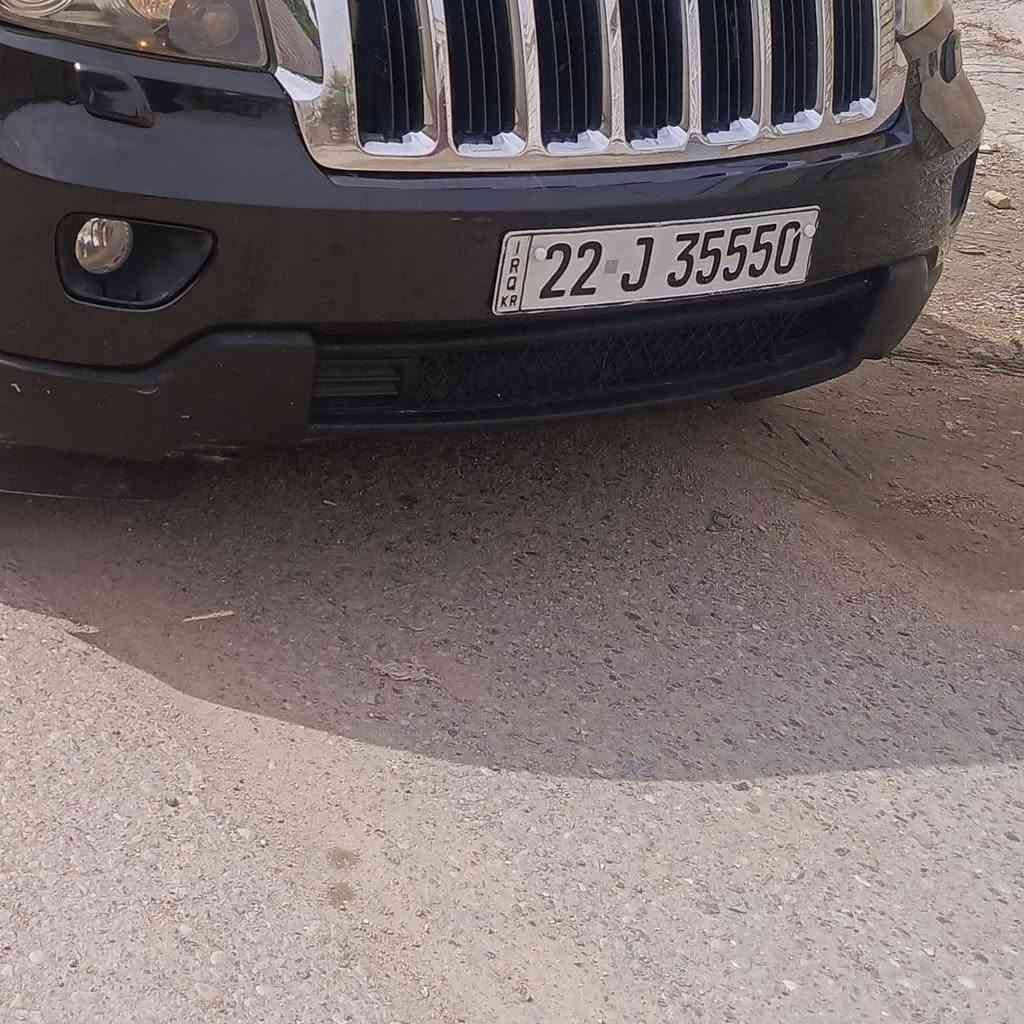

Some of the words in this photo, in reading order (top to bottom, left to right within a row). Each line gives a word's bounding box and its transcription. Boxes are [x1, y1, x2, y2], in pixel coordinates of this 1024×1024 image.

[539, 241, 602, 299] 22
[621, 237, 654, 293] J
[667, 221, 802, 288] 35550
[500, 295, 518, 308] KR
